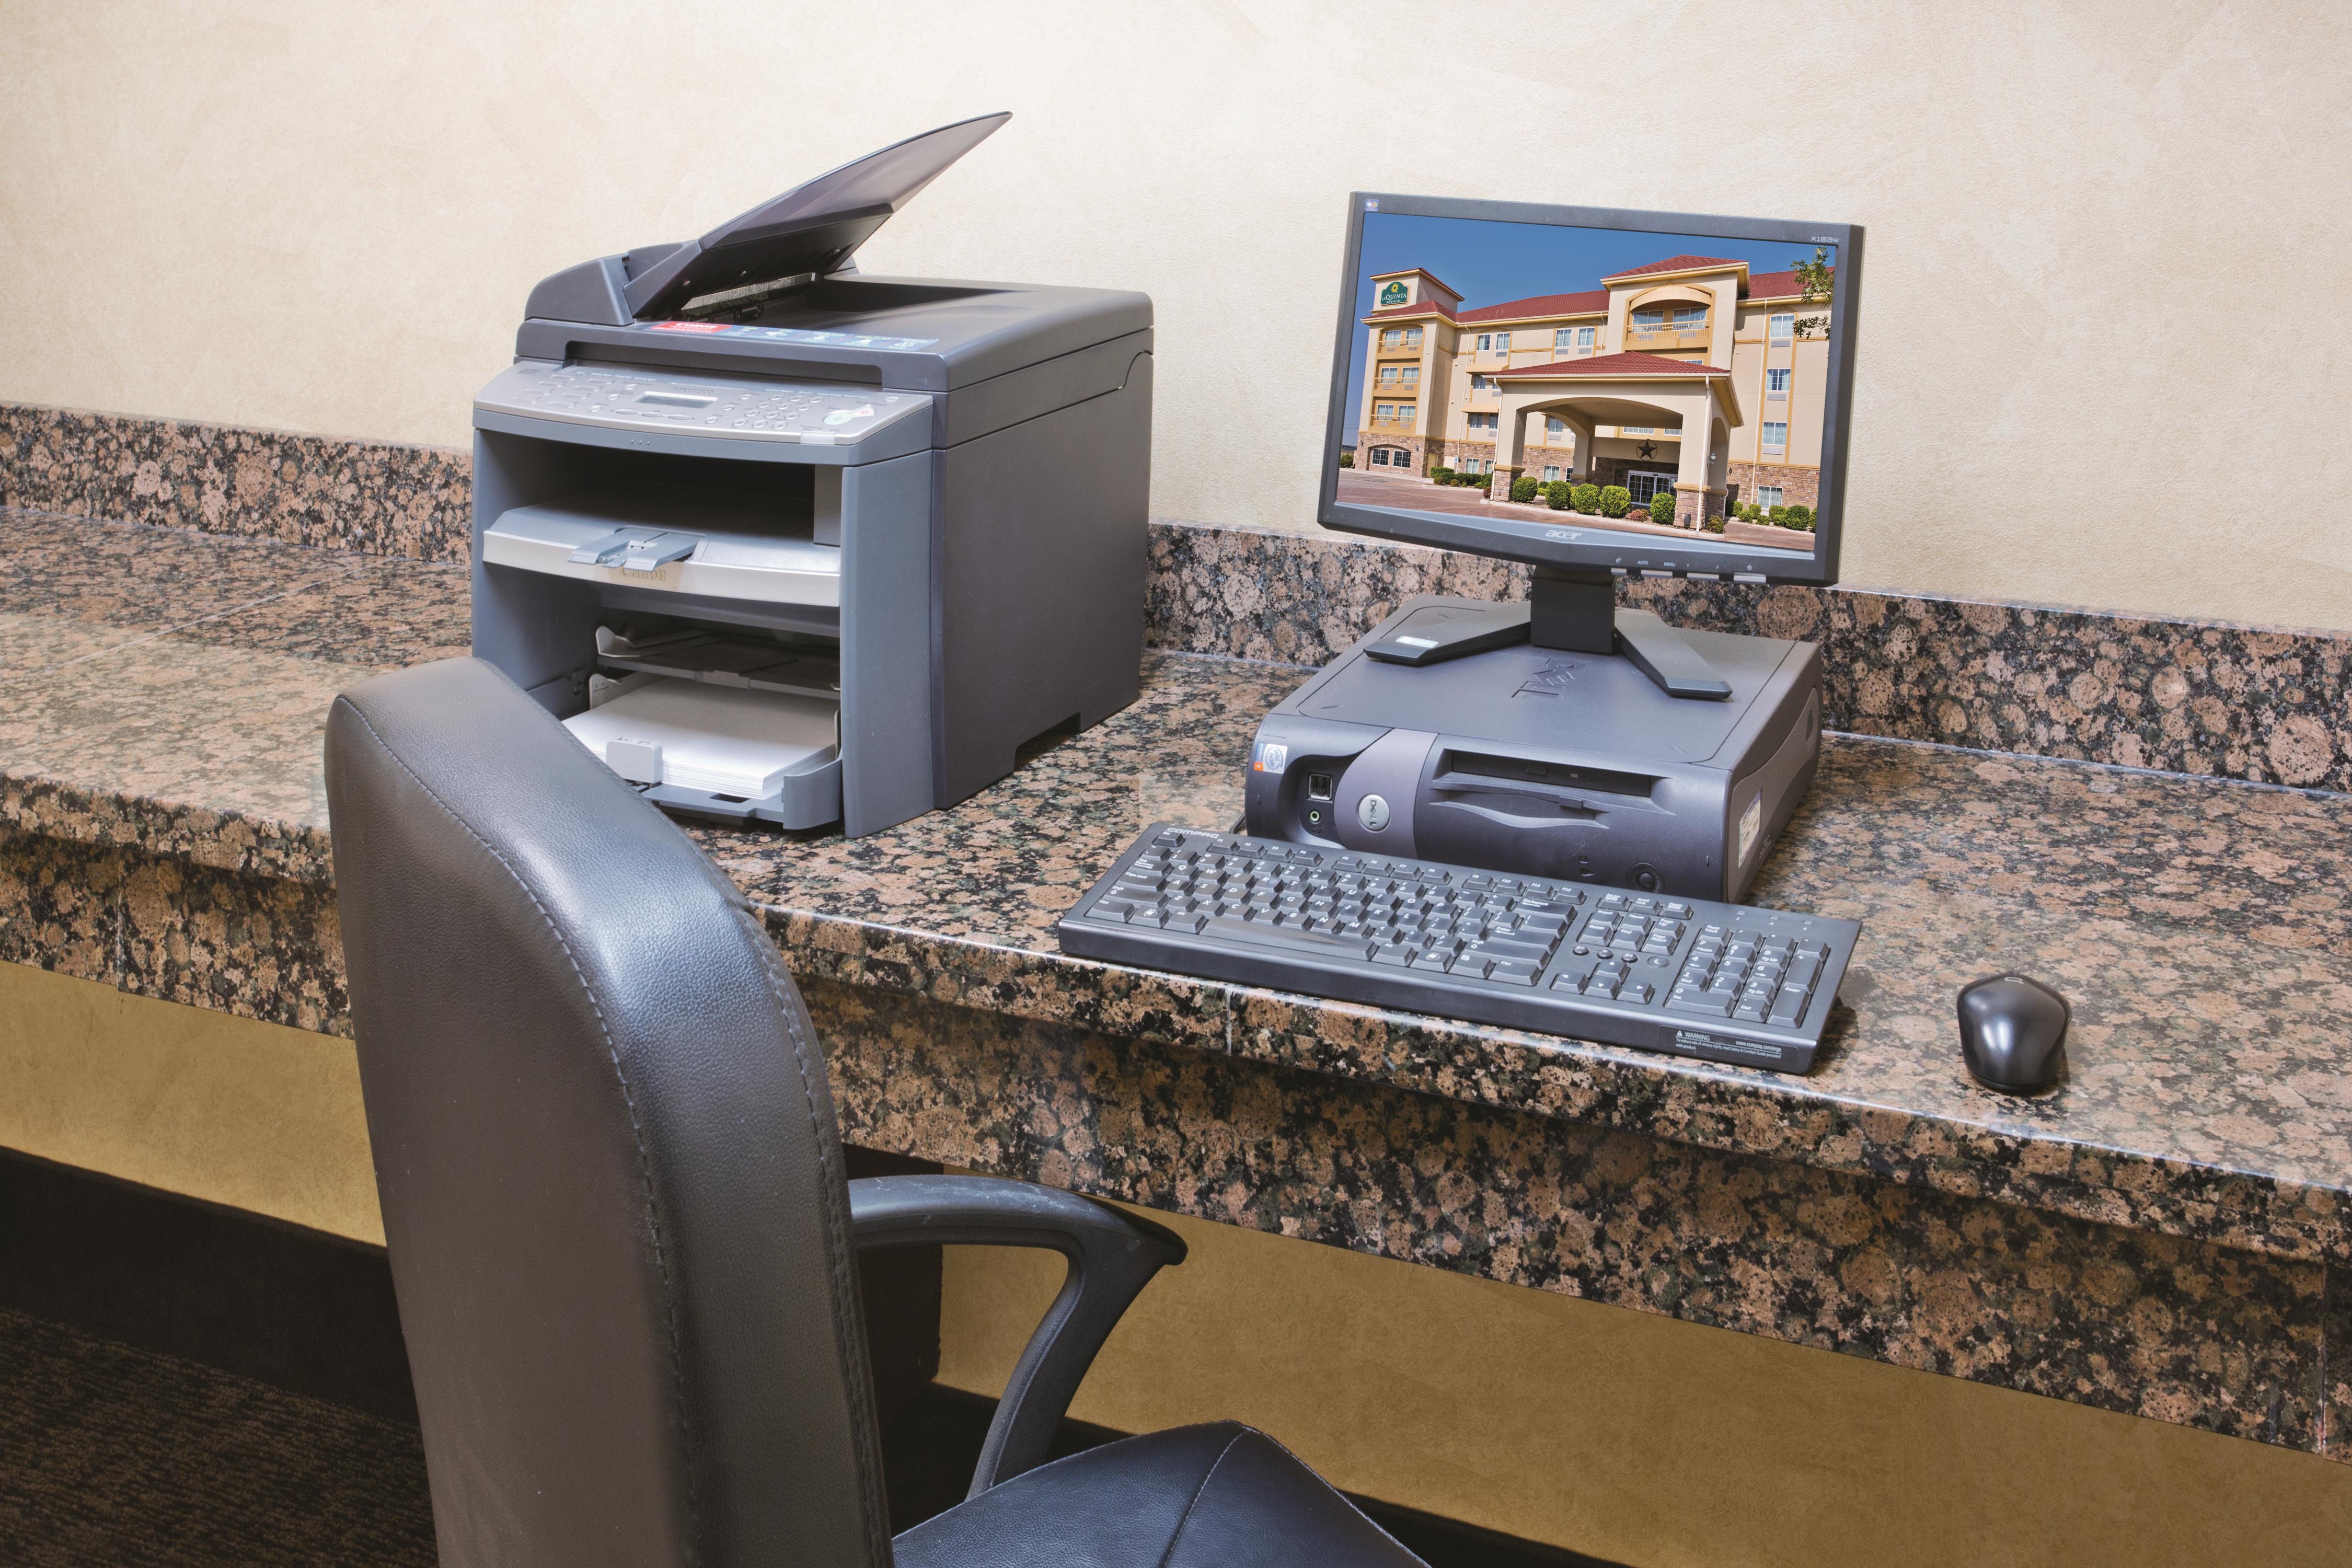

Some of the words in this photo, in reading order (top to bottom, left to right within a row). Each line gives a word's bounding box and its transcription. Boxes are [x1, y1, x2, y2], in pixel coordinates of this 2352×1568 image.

[1386, 293, 1406, 301] QUINTA
[1545, 530, 1582, 539] acer
[1166, 828, 1219, 838] COMPAQ
[1685, 1032, 1710, 1041] WARNING
[1735, 1041, 1782, 1052] www.compaq.com/ergo
